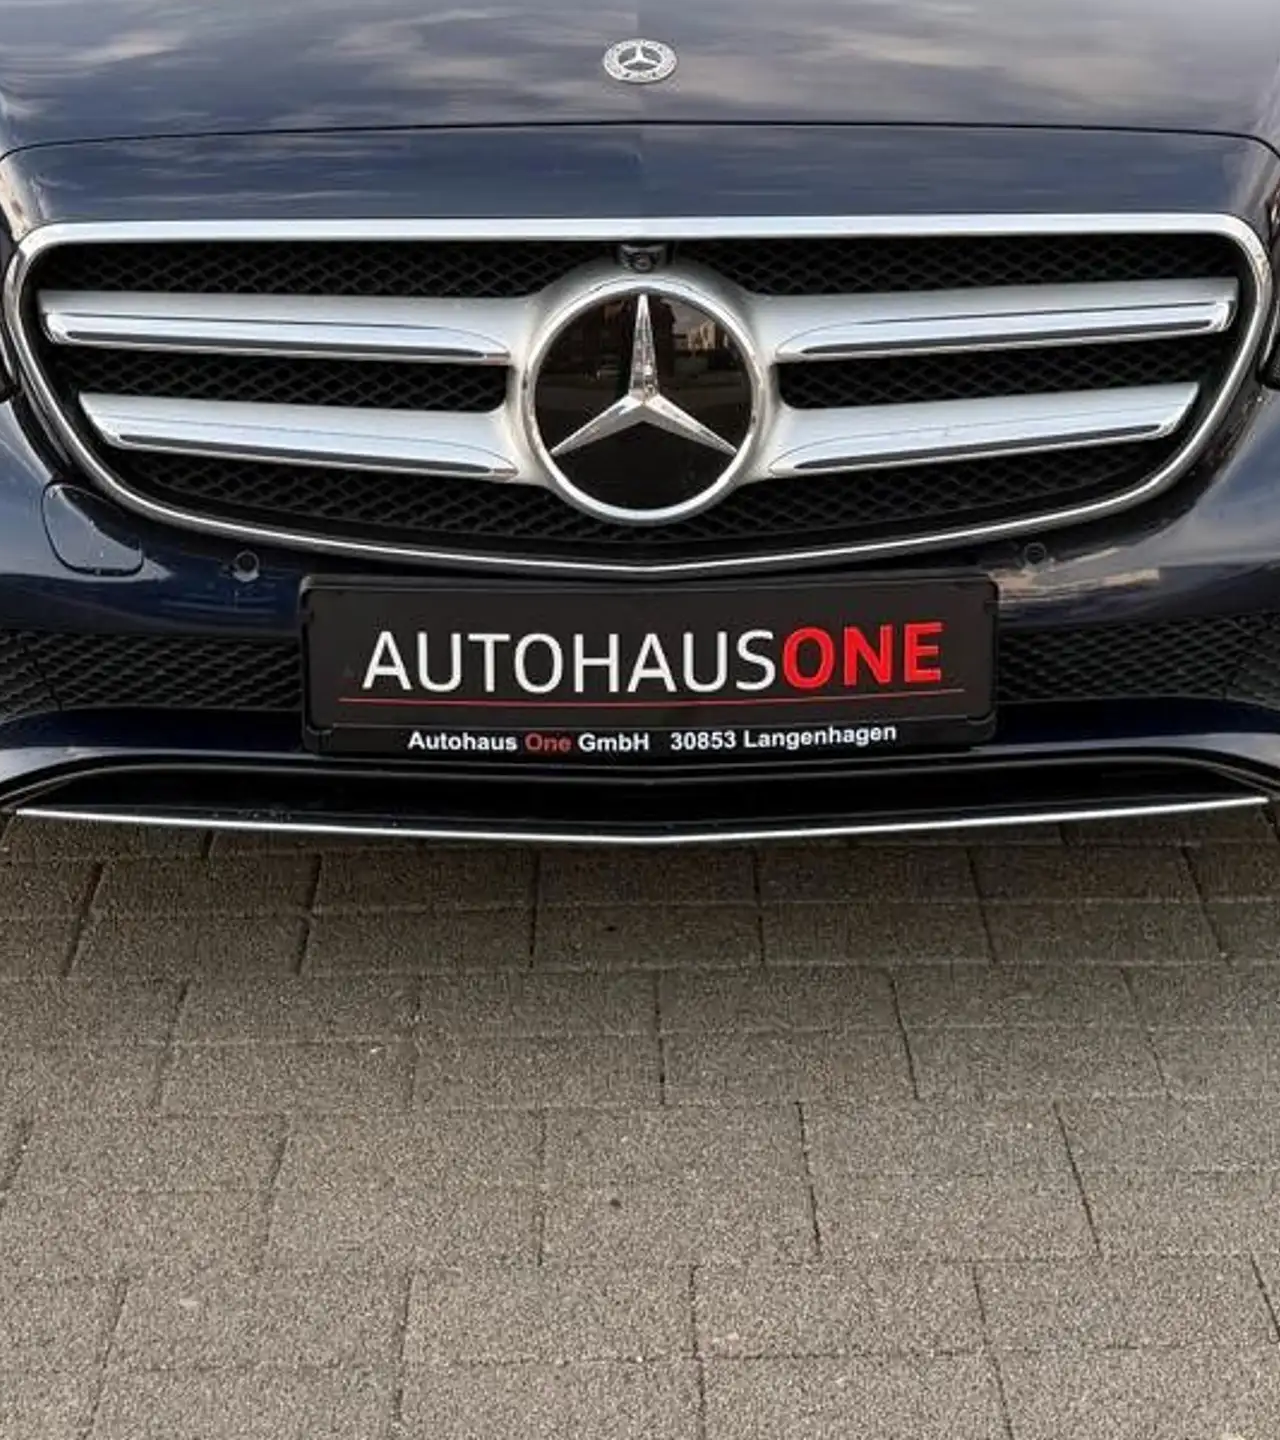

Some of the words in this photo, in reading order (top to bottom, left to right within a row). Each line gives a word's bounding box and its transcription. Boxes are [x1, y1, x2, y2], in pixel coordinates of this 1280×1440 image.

[408, 731, 518, 751] Autohaus
[524, 733, 572, 752] One
[577, 732, 650, 752] GmbH
[670, 731, 736, 751] 30853
[743, 726, 897, 750] Langenhagen
